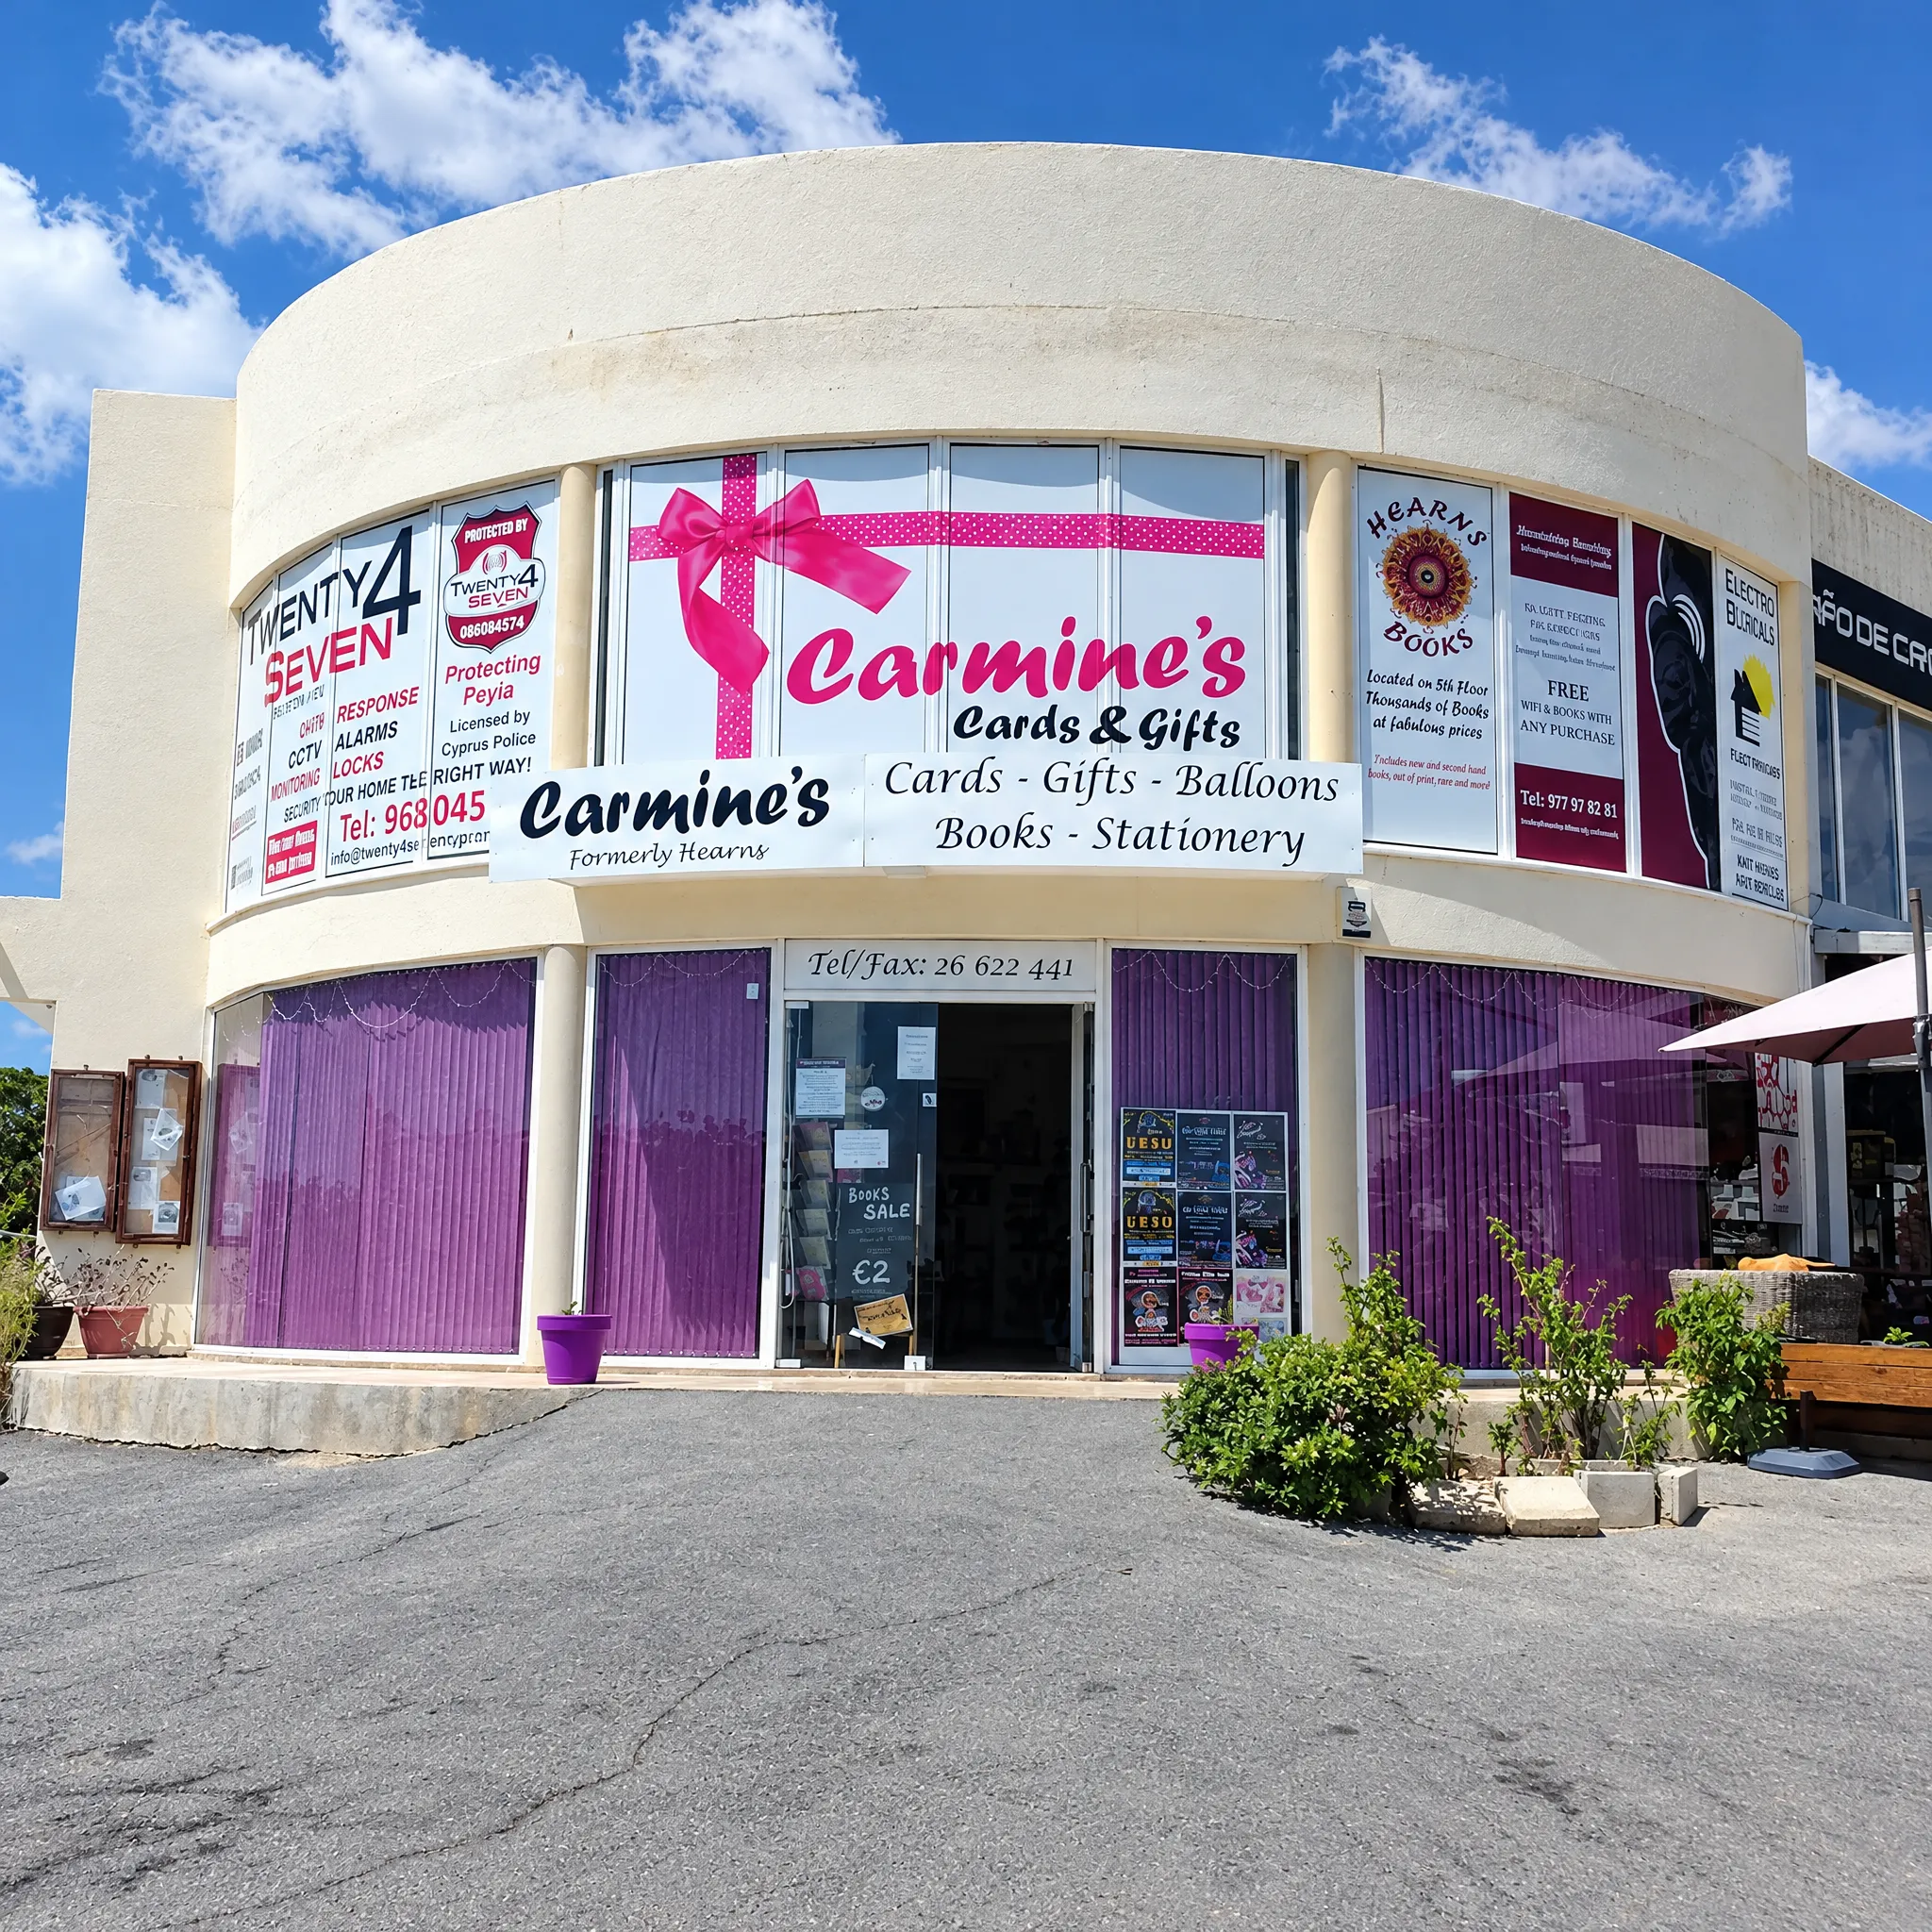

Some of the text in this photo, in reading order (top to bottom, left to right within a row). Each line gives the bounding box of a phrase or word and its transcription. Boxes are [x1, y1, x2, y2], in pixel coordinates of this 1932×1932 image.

[465, 518, 528, 543] PROTECTED BY
[469, 587, 528, 608] SEVEN
[1725, 568, 1774, 617] ELECTRO
[459, 615, 525, 639] 086084574
[1384, 621, 1474, 657] BOOKS
[1857, 615, 1890, 656] DE
[264, 617, 392, 708] SEVEN
[445, 655, 541, 684] Protecting
[786, 615, 1245, 705] Carmine's
[463, 682, 514, 707] Peyia
[1367, 669, 1489, 696] Located on 5th Floor
[1547, 679, 1590, 702] FREE
[337, 687, 419, 724] RESPONSE
[1366, 691, 1490, 719] Thousands of Books
[1521, 699, 1612, 725] WIFI & BOOKS WITH
[450, 709, 531, 733] Licensed by
[953, 704, 1241, 752] Cards & Gifts
[1373, 715, 1483, 740] at fabulous prices
[1520, 719, 1616, 746] ANY PURCHASE
[289, 741, 322, 769] CCTV
[335, 721, 398, 752] ALARMS
[442, 732, 536, 759] Cyprus Police
[271, 768, 321, 802] MONITORING
[333, 751, 384, 779] LOCKS
[1367, 768, 1391, 781] books,
[1392, 773, 1406, 781] out
[1407, 773, 1416, 784] of
[1416, 774, 1438, 787] print,
[1437, 778, 1453, 787] rare
[1454, 778, 1469, 788] and
[1408, 760, 1425, 769] new
[1426, 760, 1441, 771] and
[1442, 763, 1467, 774] second
[1468, 764, 1486, 775] hand
[284, 795, 321, 823] SECURITY
[358, 777, 397, 801] HOME
[433, 762, 485, 785] RIGHT
[490, 757, 531, 776] WAY!
[885, 757, 1003, 794] Cards
[1042, 757, 1137, 807] Gifts
[1176, 761, 1339, 803] Balloons
[520, 765, 830, 840] Carmine's
[1520, 790, 1618, 818] Tel: 977 97 82 81
[341, 809, 375, 841] Tel:
[936, 812, 1053, 849] Books
[1091, 816, 1306, 867] Stationery
[570, 841, 770, 871] Formerly Hearns
[808, 949, 1074, 981] Tel/Fax: 26 622 441
[849, 1187, 890, 1204] BOOKS
[863, 1203, 910, 1220] SALE
[852, 1259, 891, 1284] €2
